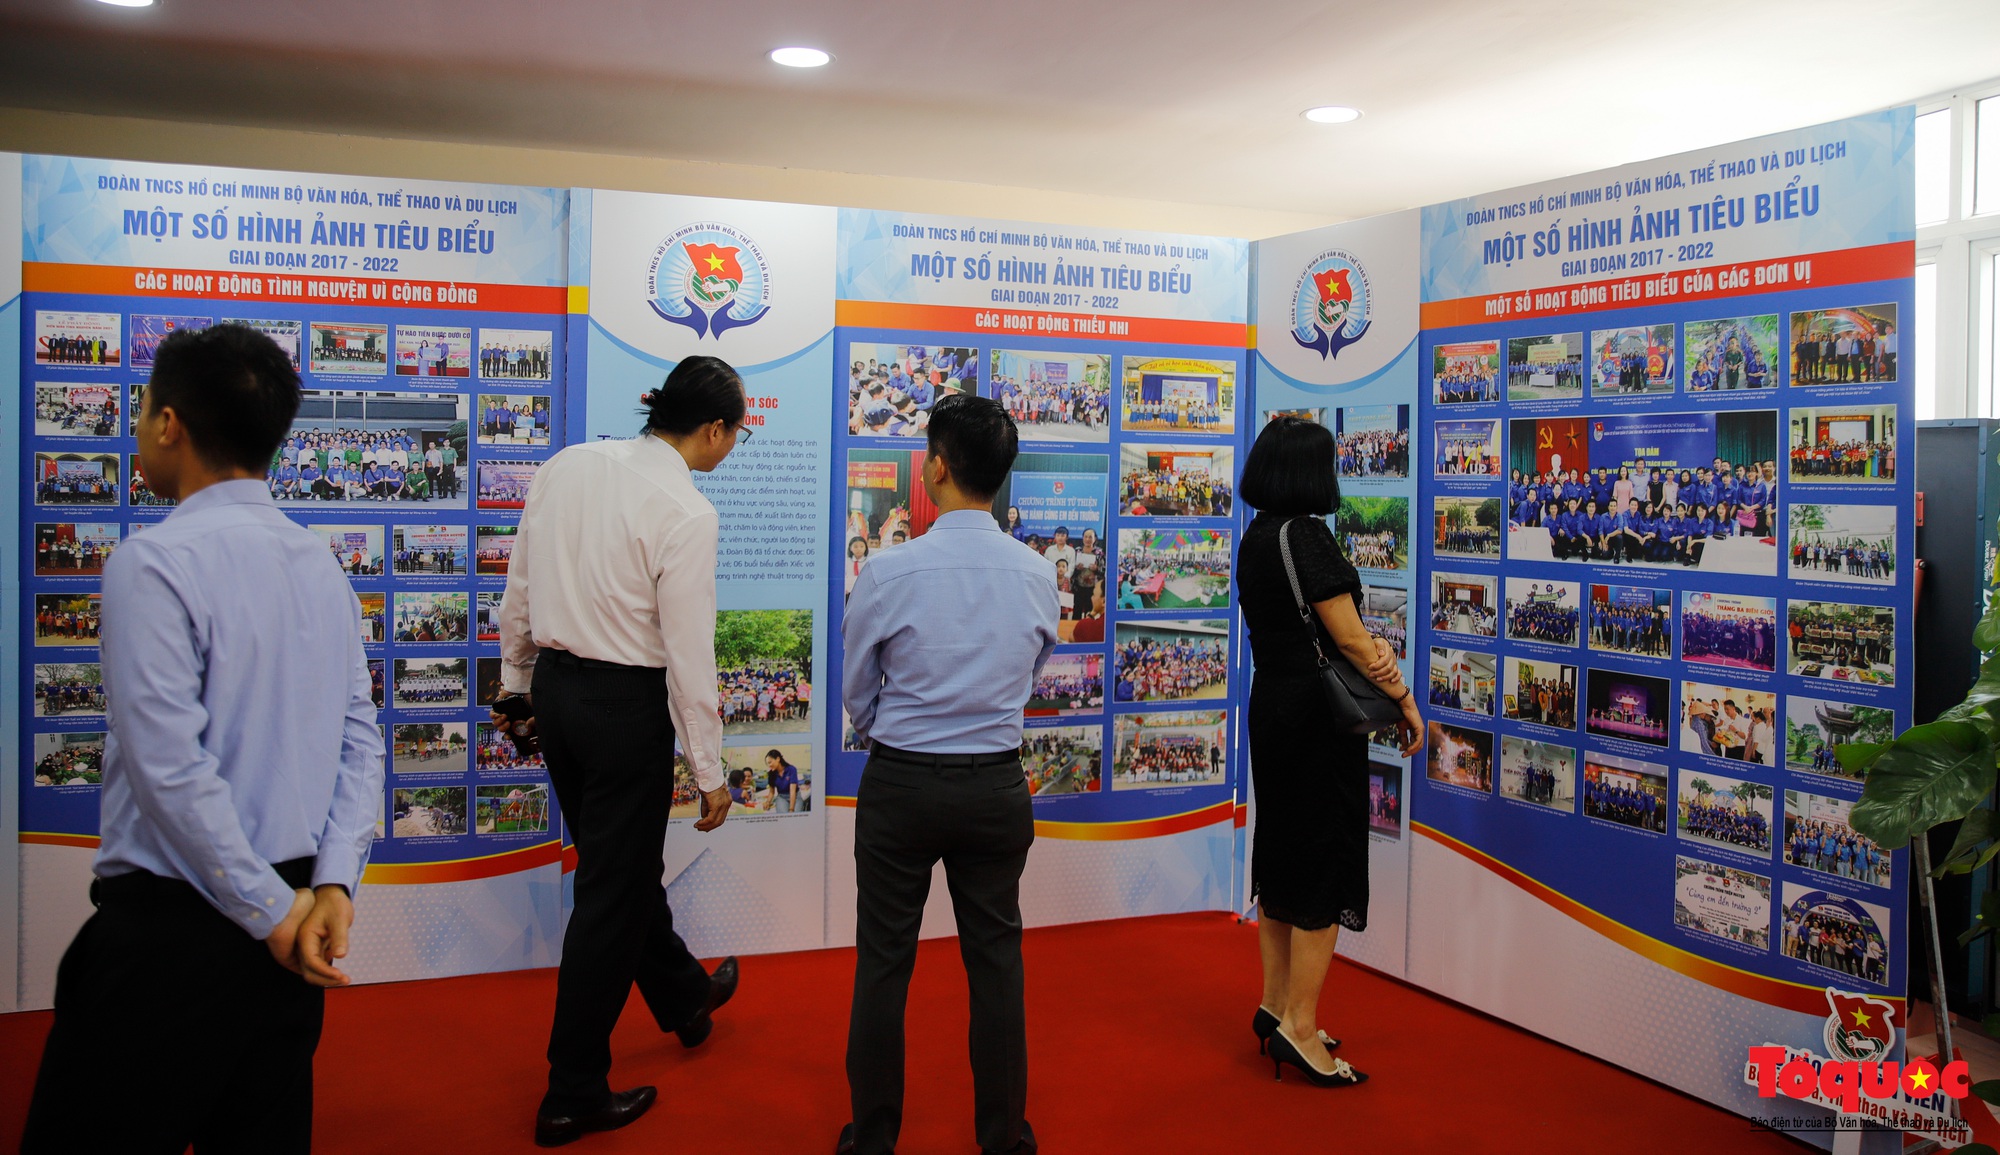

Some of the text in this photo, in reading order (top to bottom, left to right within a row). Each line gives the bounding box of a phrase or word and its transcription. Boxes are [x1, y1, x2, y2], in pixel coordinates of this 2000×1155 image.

[97, 174, 516, 216] ĐOÀN TNCS HỒ CHÍ MINH BỘ VĂN HÓA, THỂ THAO VÀ DU LỊCH
[1466, 140, 1846, 226] ĐOÀN TNCS HỒ CHÍ MINH BỘ VĂN HÓA, THỂ THAO VÀ DU LỊCH
[122, 205, 494, 254] MỘT SỐ HÌNH ẢNH TIÊU BIỂU
[1483, 174, 1819, 265] MỘT SỐ HÌNH ẢNH TIÊU BIỂU
[892, 223, 1208, 260] ĐOÀN TNCS HỒ CHÍ MINH BỘ VĂN HÓA, THỂ THAO VÀ DU LỊCH
[1561, 259, 1586, 277] GIAI
[1590, 253, 1626, 274] ĐOẠN
[1630, 248, 1663, 268] 2017
[1678, 241, 1713, 262] 2022
[229, 249, 259, 265] GIAI
[264, 251, 306, 267] ĐOẠN
[311, 253, 347, 269] 2017
[362, 256, 398, 272] 2022
[910, 250, 1191, 294] MỘT SỐ HÌNH ẢNH TIÊU BIỂU
[135, 270, 477, 303] CÁC HOẠT ĐỘNG TÌNH NGUYỆN VÌ CỘNG ĐỒNG
[991, 288, 1014, 302] GIAI
[1017, 290, 1049, 306] ĐOẠN
[1053, 292, 1080, 306] 2017
[1091, 295, 1118, 309] 2022
[1485, 260, 1810, 317] MỘT SỐ HOẠT ĐỘNG TIÊU BIỂU CỦA CÁC ĐƠN VỊ
[975, 310, 1128, 335] CÁC HOẠT ĐỘNG THIẾU NHI
[758, 396, 778, 408] SÓC
[786, 439, 803, 447] động
[716, 486, 728, 495] xây
[729, 487, 746, 495] dựng
[758, 486, 774, 494] điểm
